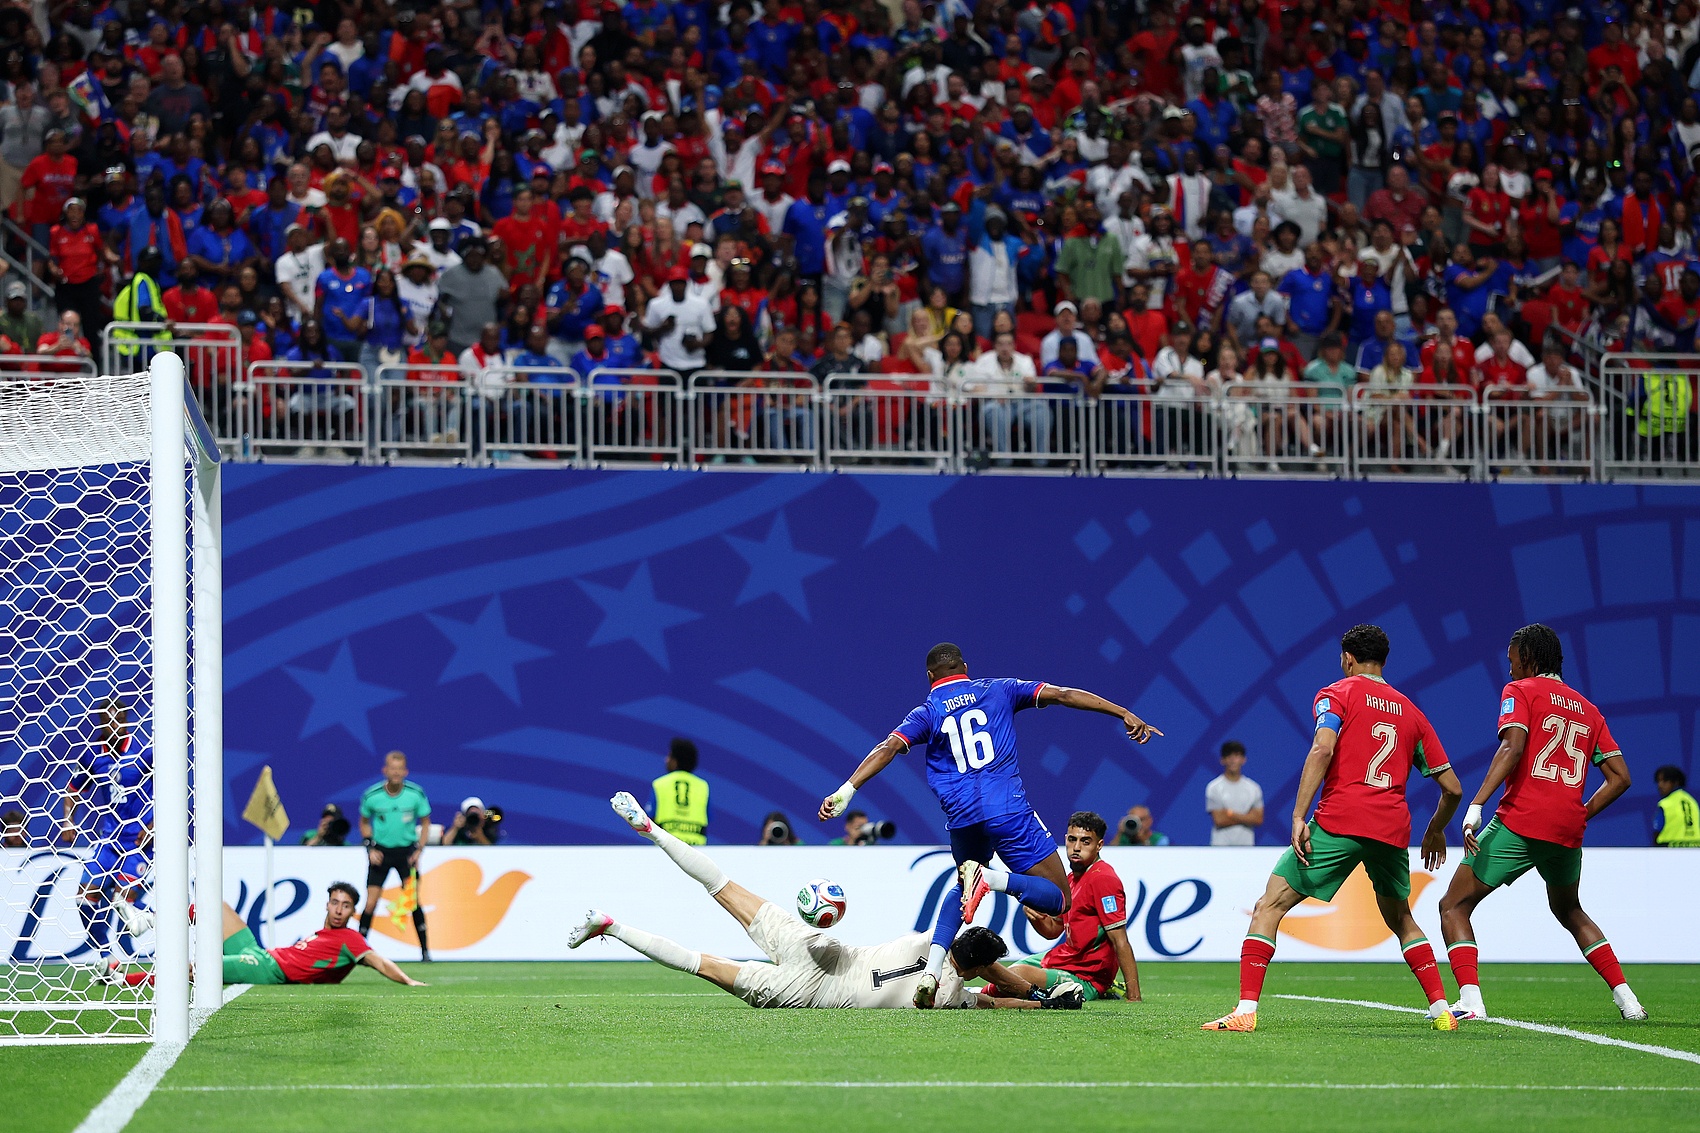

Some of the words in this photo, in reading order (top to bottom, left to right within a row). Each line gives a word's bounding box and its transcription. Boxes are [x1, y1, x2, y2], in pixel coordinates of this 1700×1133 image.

[942, 693, 977, 713] JOSEPH
[1366, 694, 1403, 716] HAKIMI
[1550, 693, 1585, 715] HALHAL
[941, 709, 995, 773] 16
[1364, 722, 1398, 789] 2
[1531, 714, 1591, 788] 25
[871, 956, 928, 991] 1
